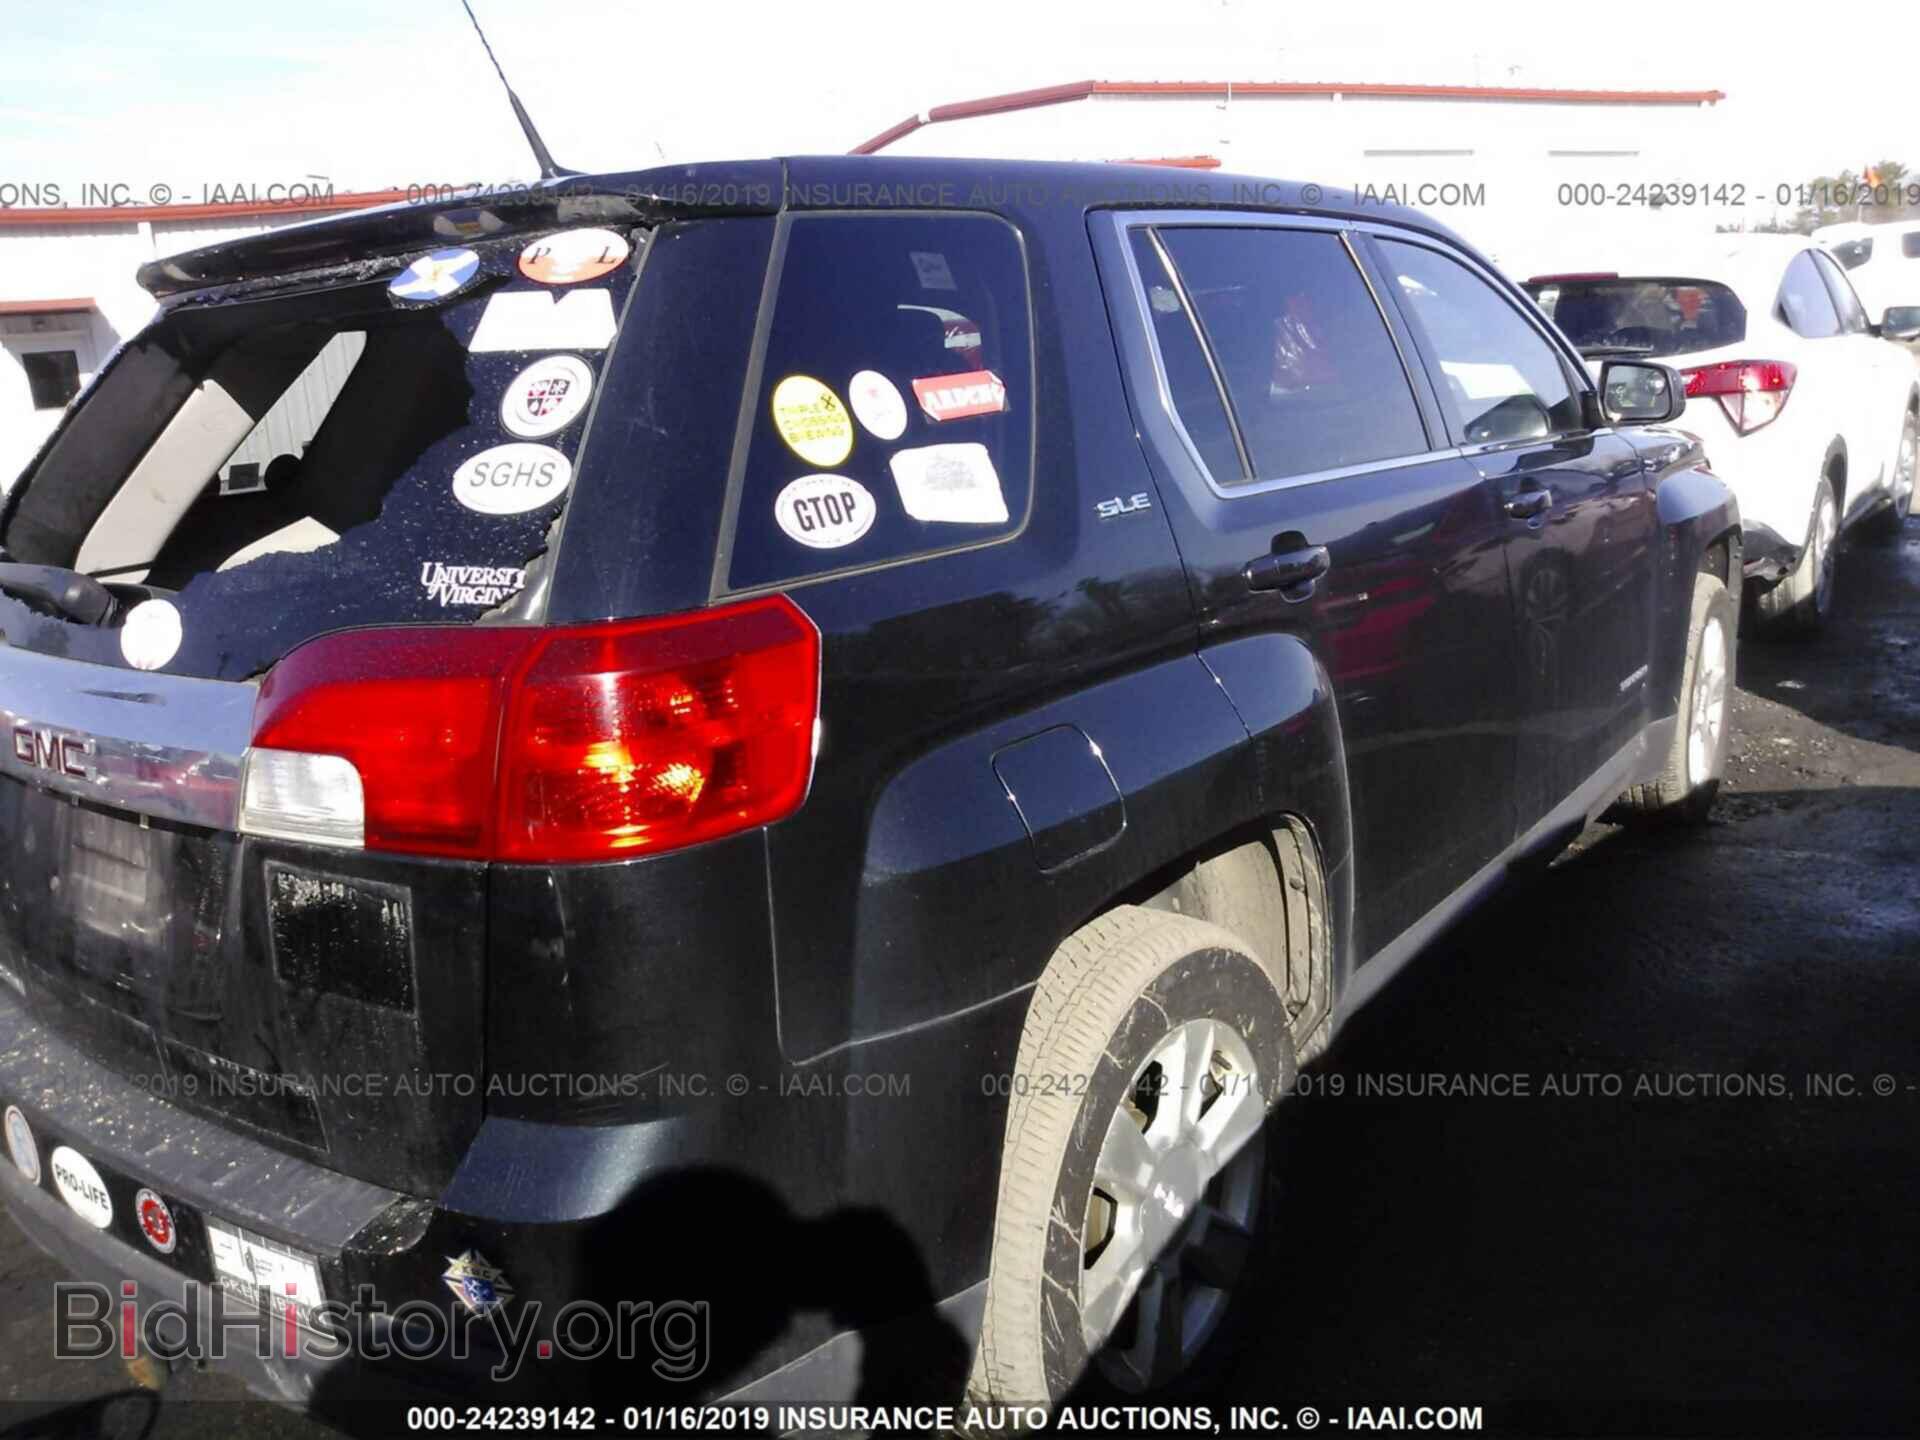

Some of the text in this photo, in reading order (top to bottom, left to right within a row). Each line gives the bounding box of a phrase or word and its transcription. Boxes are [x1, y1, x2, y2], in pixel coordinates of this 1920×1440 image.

[469, 461, 556, 488] SGHS
[793, 491, 857, 532] GTOP
[1096, 492, 1151, 518] SLE
[421, 562, 527, 589] UNIVERSIT
[439, 584, 517, 607] VIRGIN
[13, 727, 92, 779] GMC
[55, 1163, 109, 1211] PRO-LIFE
